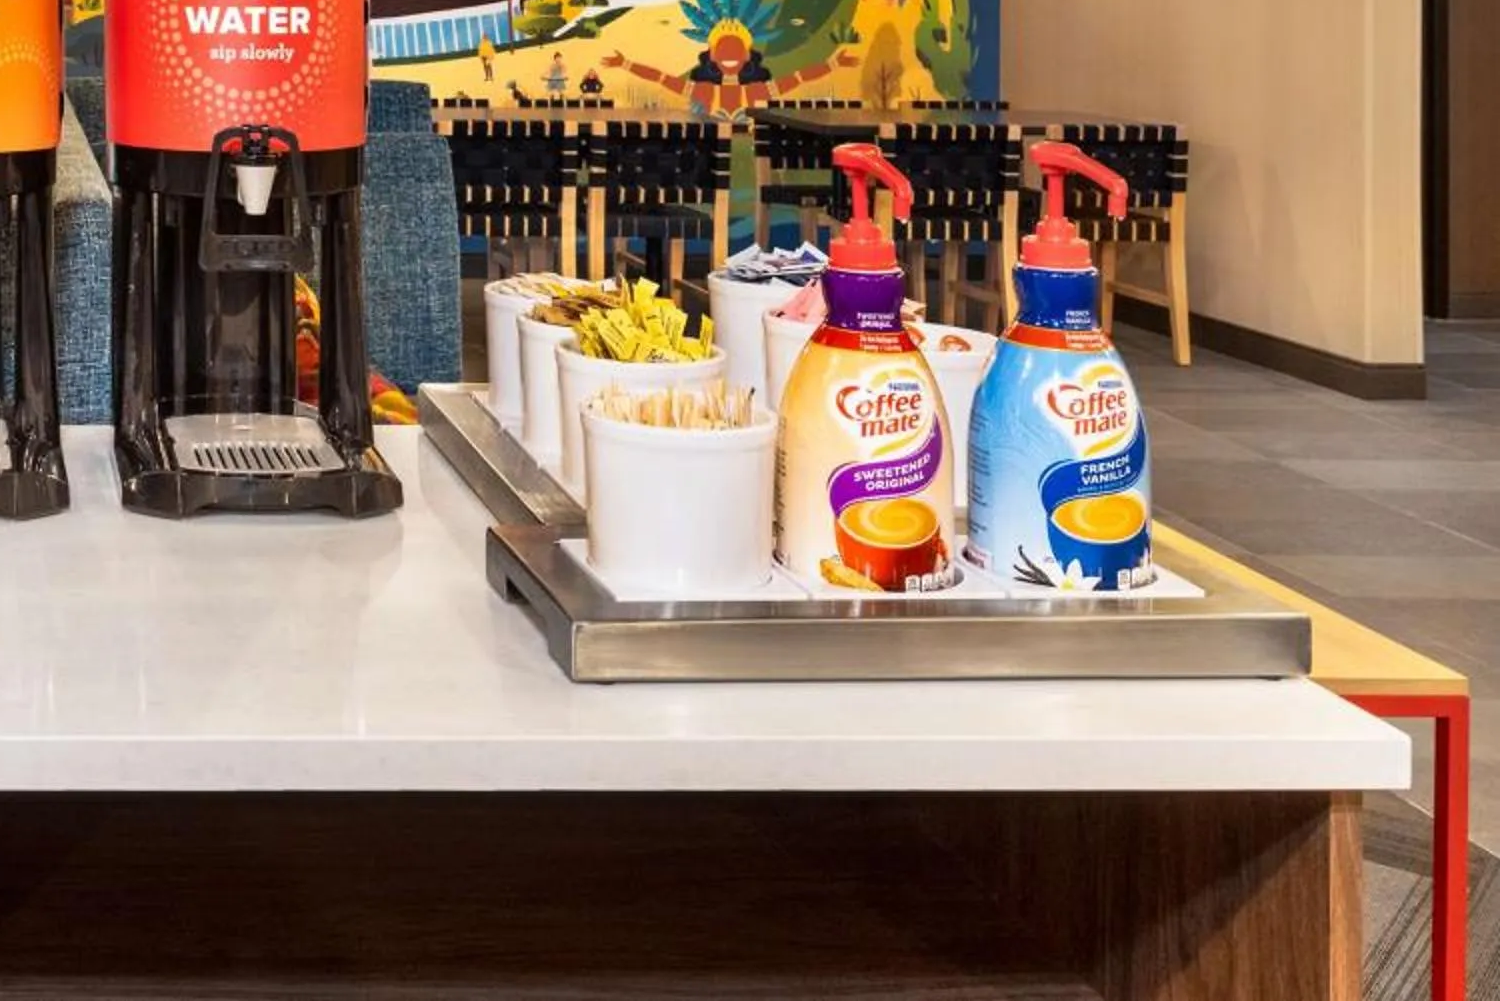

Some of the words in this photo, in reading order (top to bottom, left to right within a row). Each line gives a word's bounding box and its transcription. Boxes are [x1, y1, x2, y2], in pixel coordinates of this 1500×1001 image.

[184, 6, 311, 35] WATER
[209, 44, 237, 63] sip
[241, 42, 295, 63] slowly
[835, 385, 922, 421] Coffee
[1047, 384, 1127, 420] Coffee
[861, 413, 920, 437] mate
[1074, 410, 1127, 435] mate
[853, 452, 931, 482] SWEETENED
[1081, 454, 1130, 474] FRENCH
[1081, 466, 1131, 486] VANILLA
[865, 471, 925, 491] ORIGINAL
